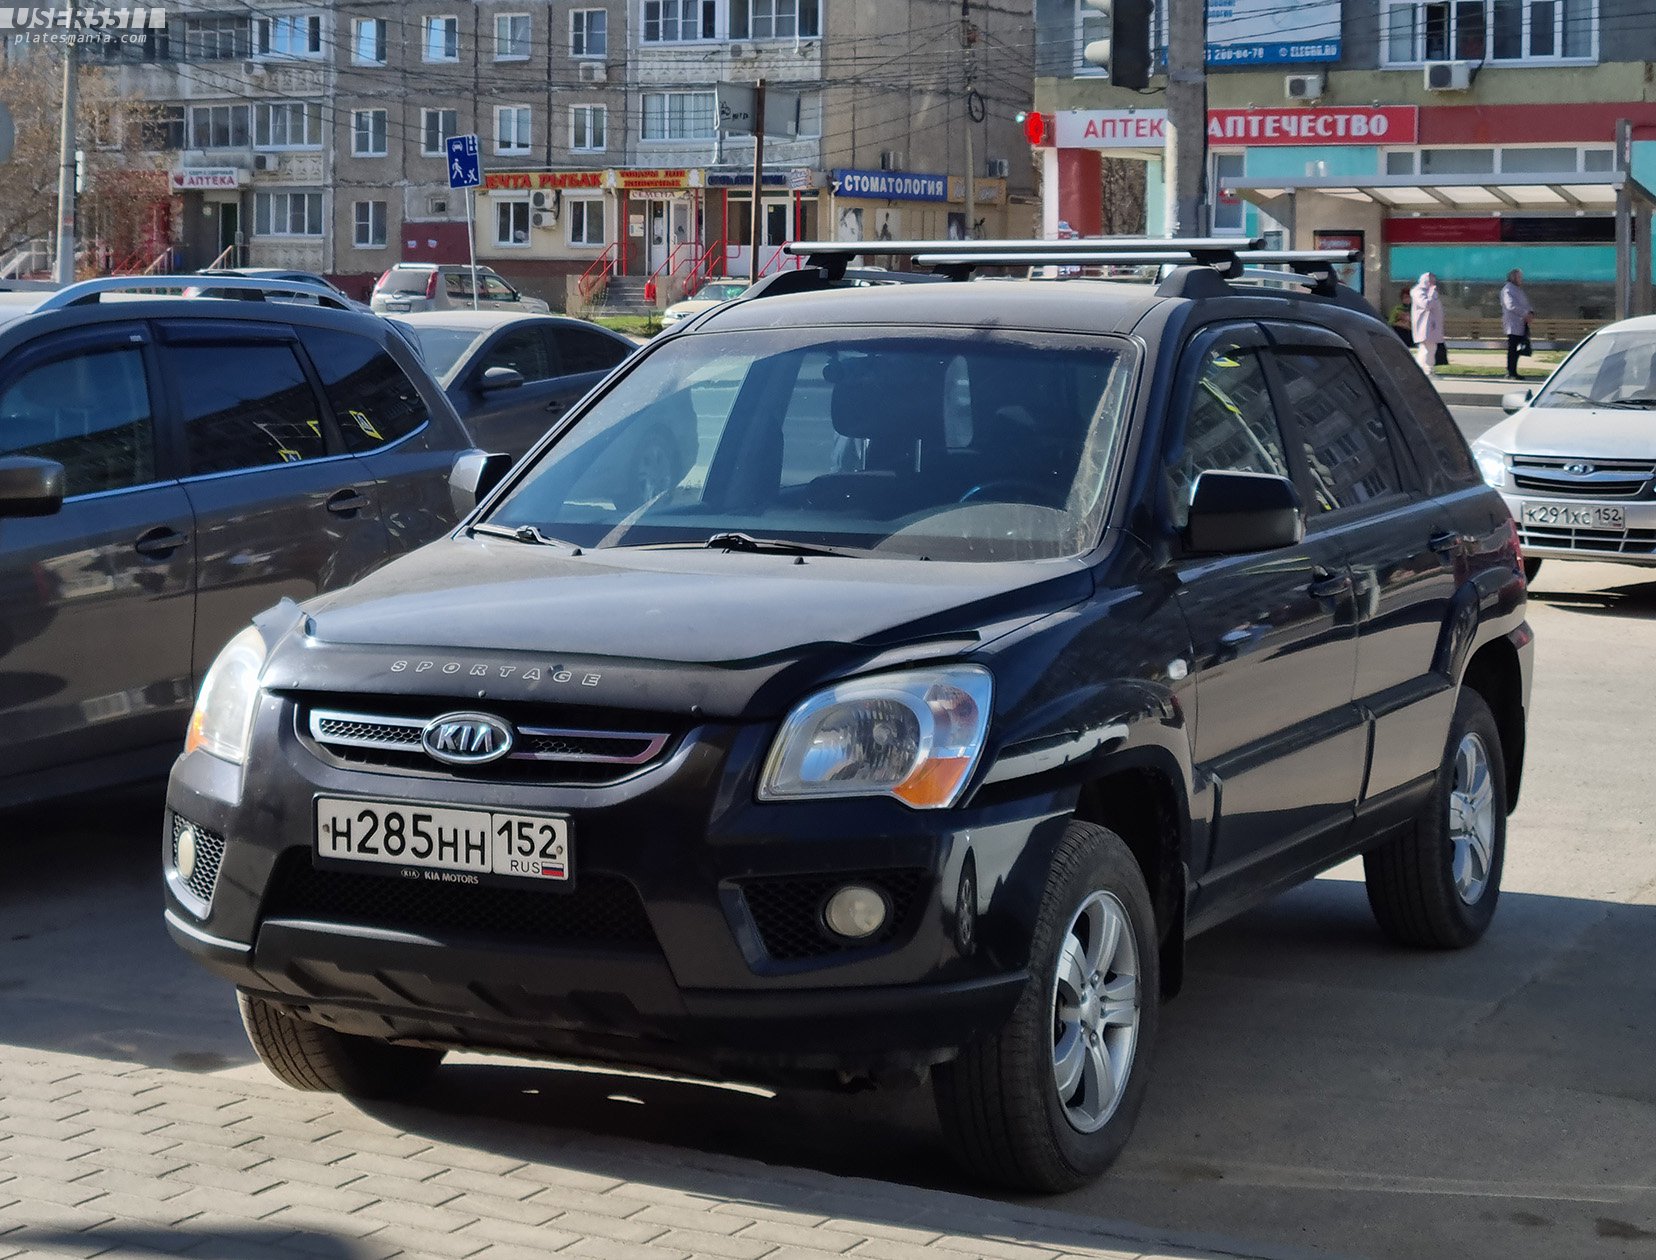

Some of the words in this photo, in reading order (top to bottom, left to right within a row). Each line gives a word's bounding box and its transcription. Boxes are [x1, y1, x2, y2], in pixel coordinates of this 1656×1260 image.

[1084, 118, 1165, 139] АПТЕК
[1208, 114, 1388, 138] АПТЕЧЕСТВО
[188, 176, 235, 186] АПТЕКА
[485, 173, 532, 189] ЕЧТА
[844, 174, 944, 196] СТОМАТОЛОГИЯ
[1595, 508, 1620, 521] 152
[390, 661, 602, 686] SPORTAGE
[436, 724, 494, 753] KIA
[331, 809, 486, 866] Н285НН
[497, 820, 558, 860] 152
[424, 871, 440, 880] KIA
[442, 873, 479, 884] MOTORS
[510, 860, 541, 874] RUS
